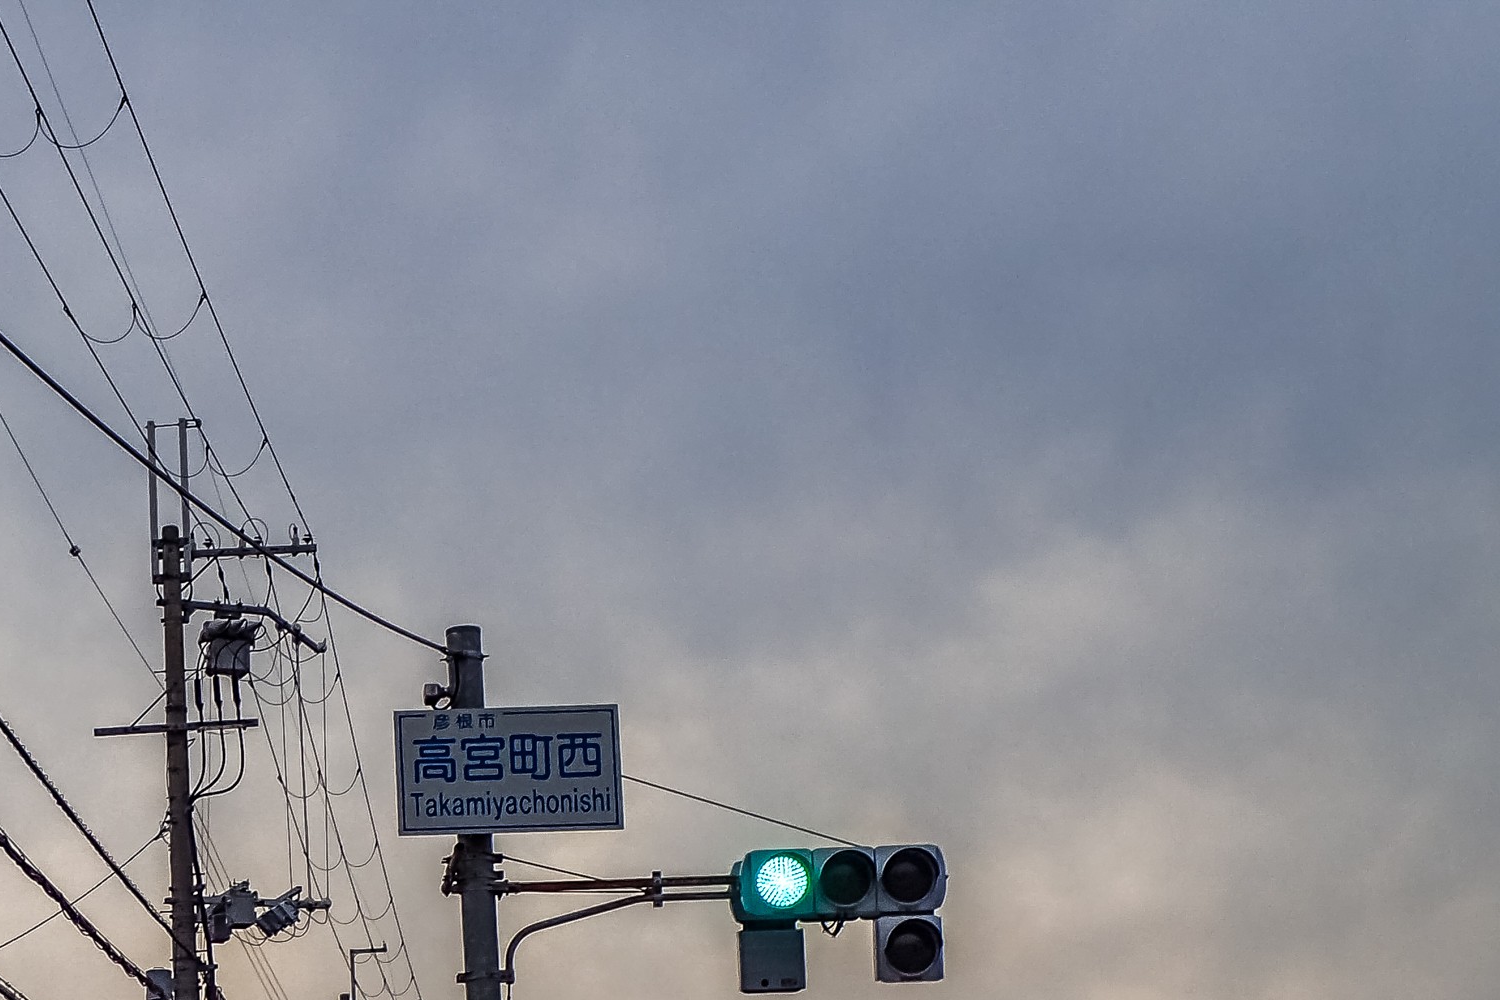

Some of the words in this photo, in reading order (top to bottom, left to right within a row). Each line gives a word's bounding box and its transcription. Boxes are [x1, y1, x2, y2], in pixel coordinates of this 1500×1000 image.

[432, 713, 496, 731] 彦根市
[412, 732, 602, 784] 高宮町西
[410, 787, 612, 820] Takamiyachonishi
